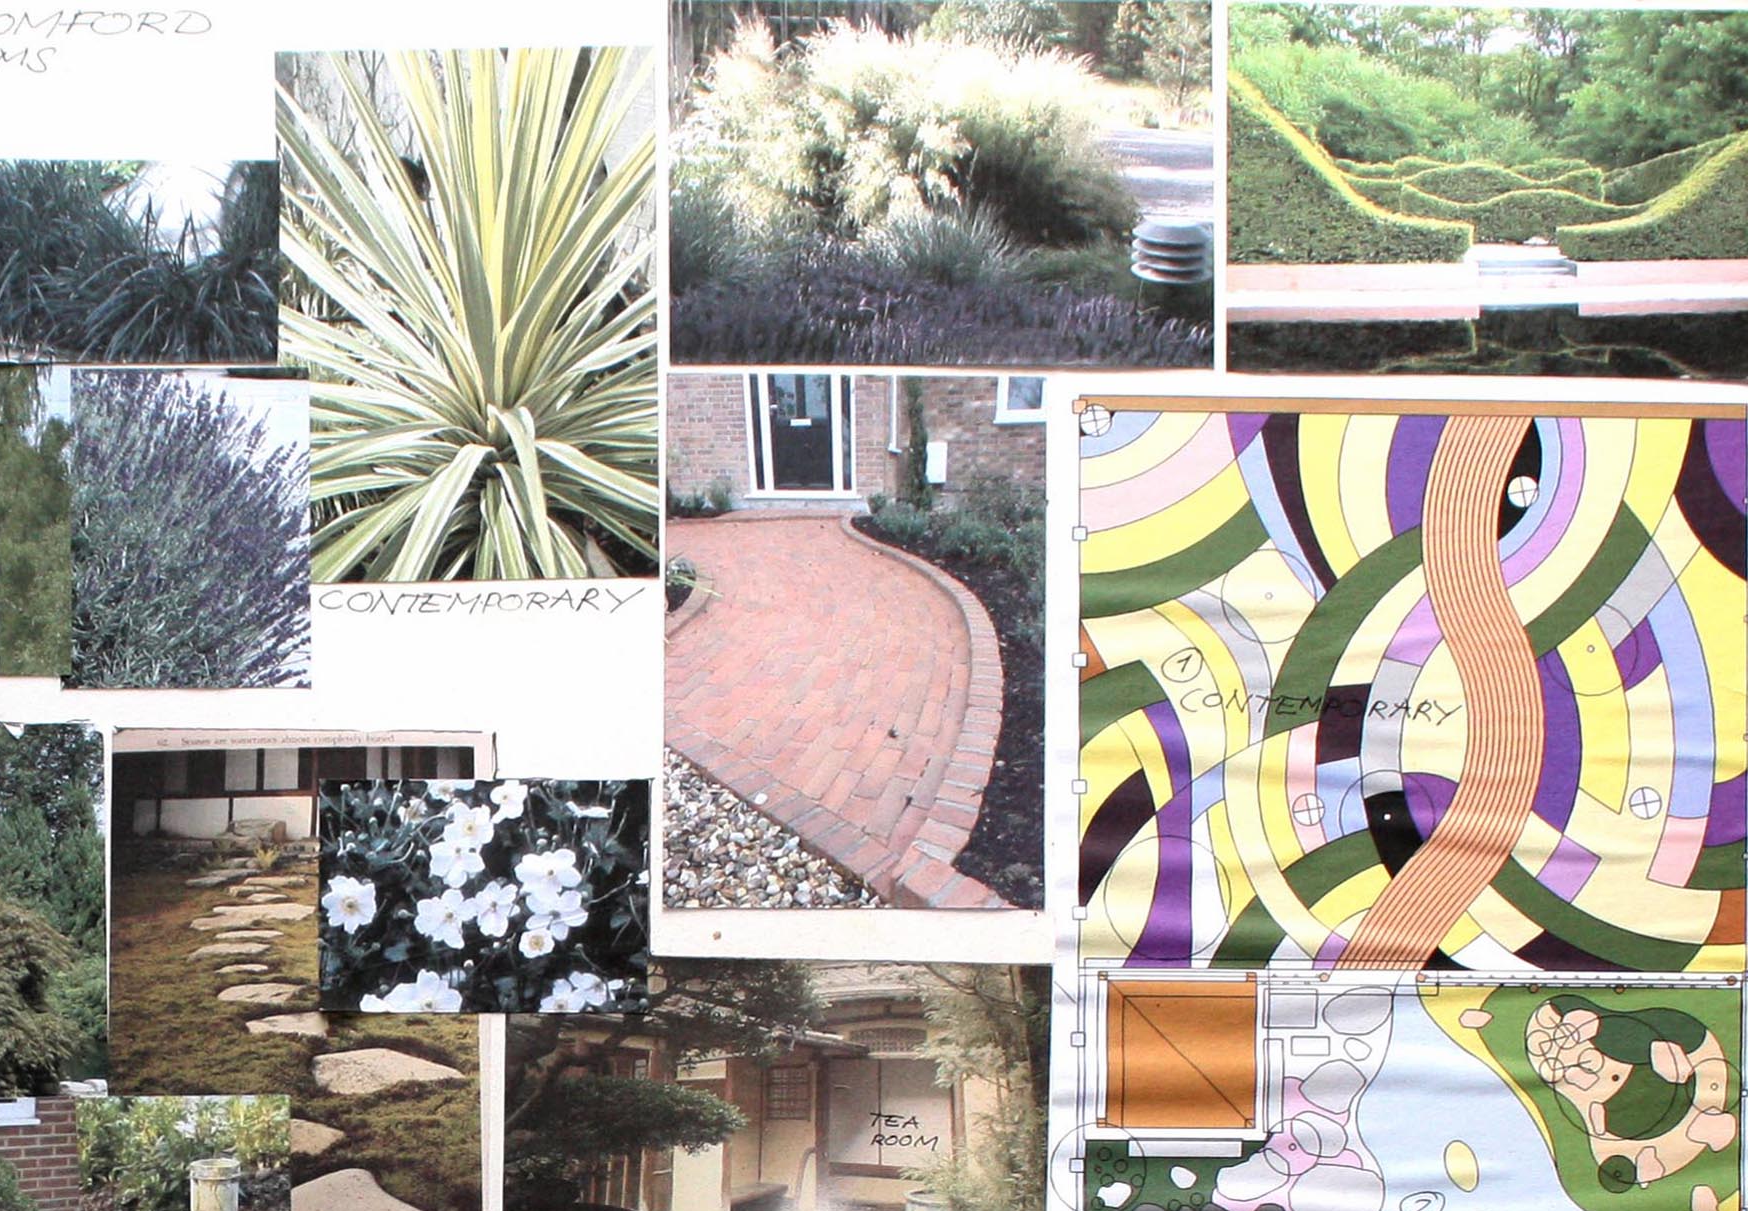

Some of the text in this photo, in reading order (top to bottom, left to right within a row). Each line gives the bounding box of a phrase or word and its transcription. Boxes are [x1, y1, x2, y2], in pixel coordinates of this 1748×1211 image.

[318, 586, 646, 616] CONTEMPORARY
[1178, 687, 1464, 727] CONTEMPORARY
[869, 1111, 921, 1130] TEA
[869, 1132, 939, 1152] ROOM
